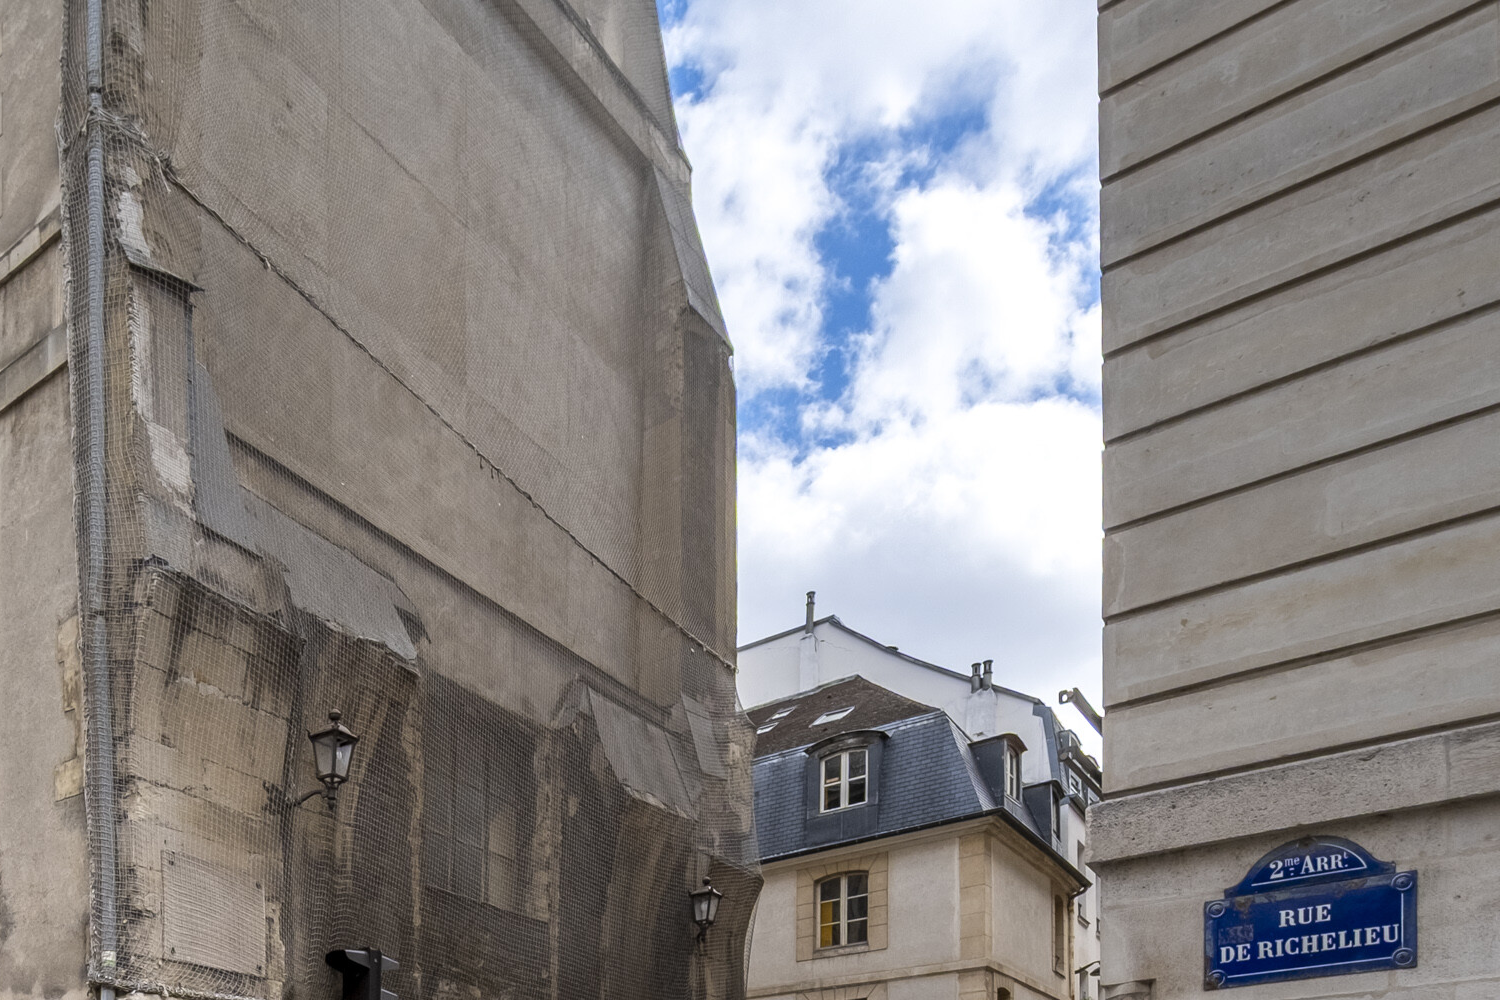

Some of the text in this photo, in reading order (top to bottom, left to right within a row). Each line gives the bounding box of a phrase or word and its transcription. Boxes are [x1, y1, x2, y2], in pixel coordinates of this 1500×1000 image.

[1278, 903, 1332, 928] RUE
[1219, 923, 1400, 964] DE RICHELIEU
